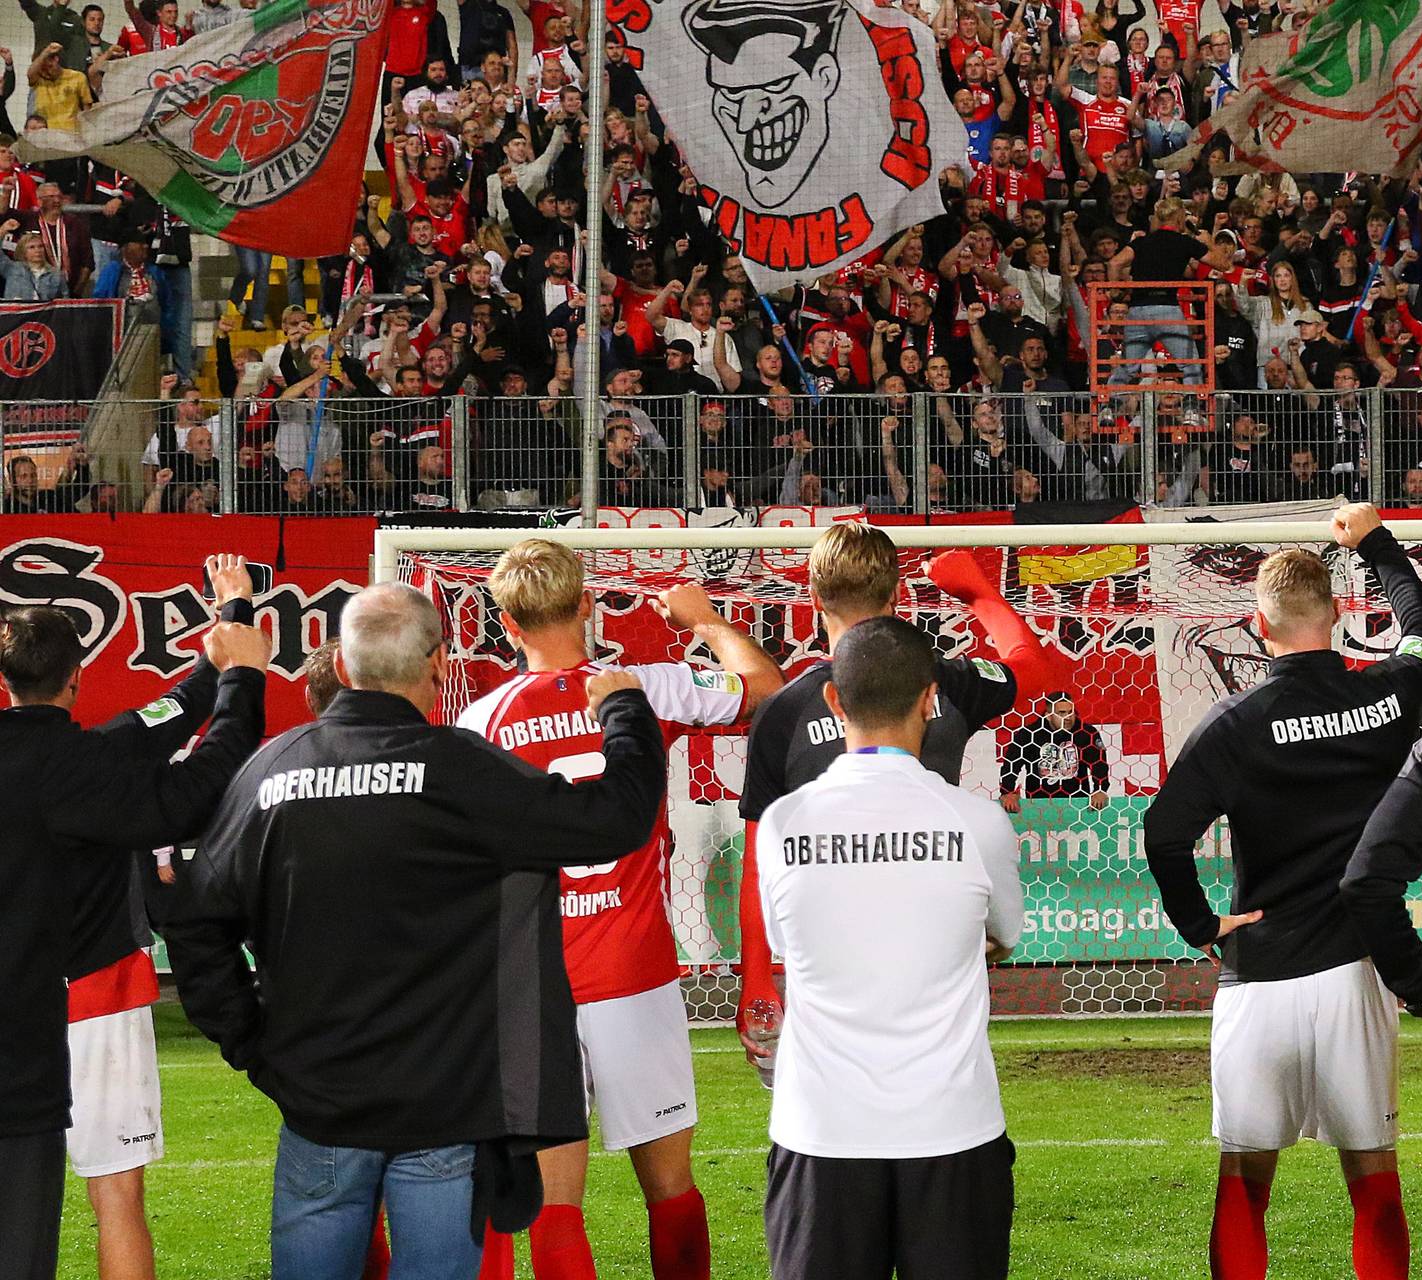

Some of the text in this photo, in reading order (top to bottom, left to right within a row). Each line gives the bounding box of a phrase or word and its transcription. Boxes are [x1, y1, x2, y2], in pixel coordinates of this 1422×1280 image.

[1271, 693, 1402, 745] OBERHAUSEN
[259, 762, 426, 811] OBERHAUSEN
[783, 831, 964, 866] OBERHAUSEN
